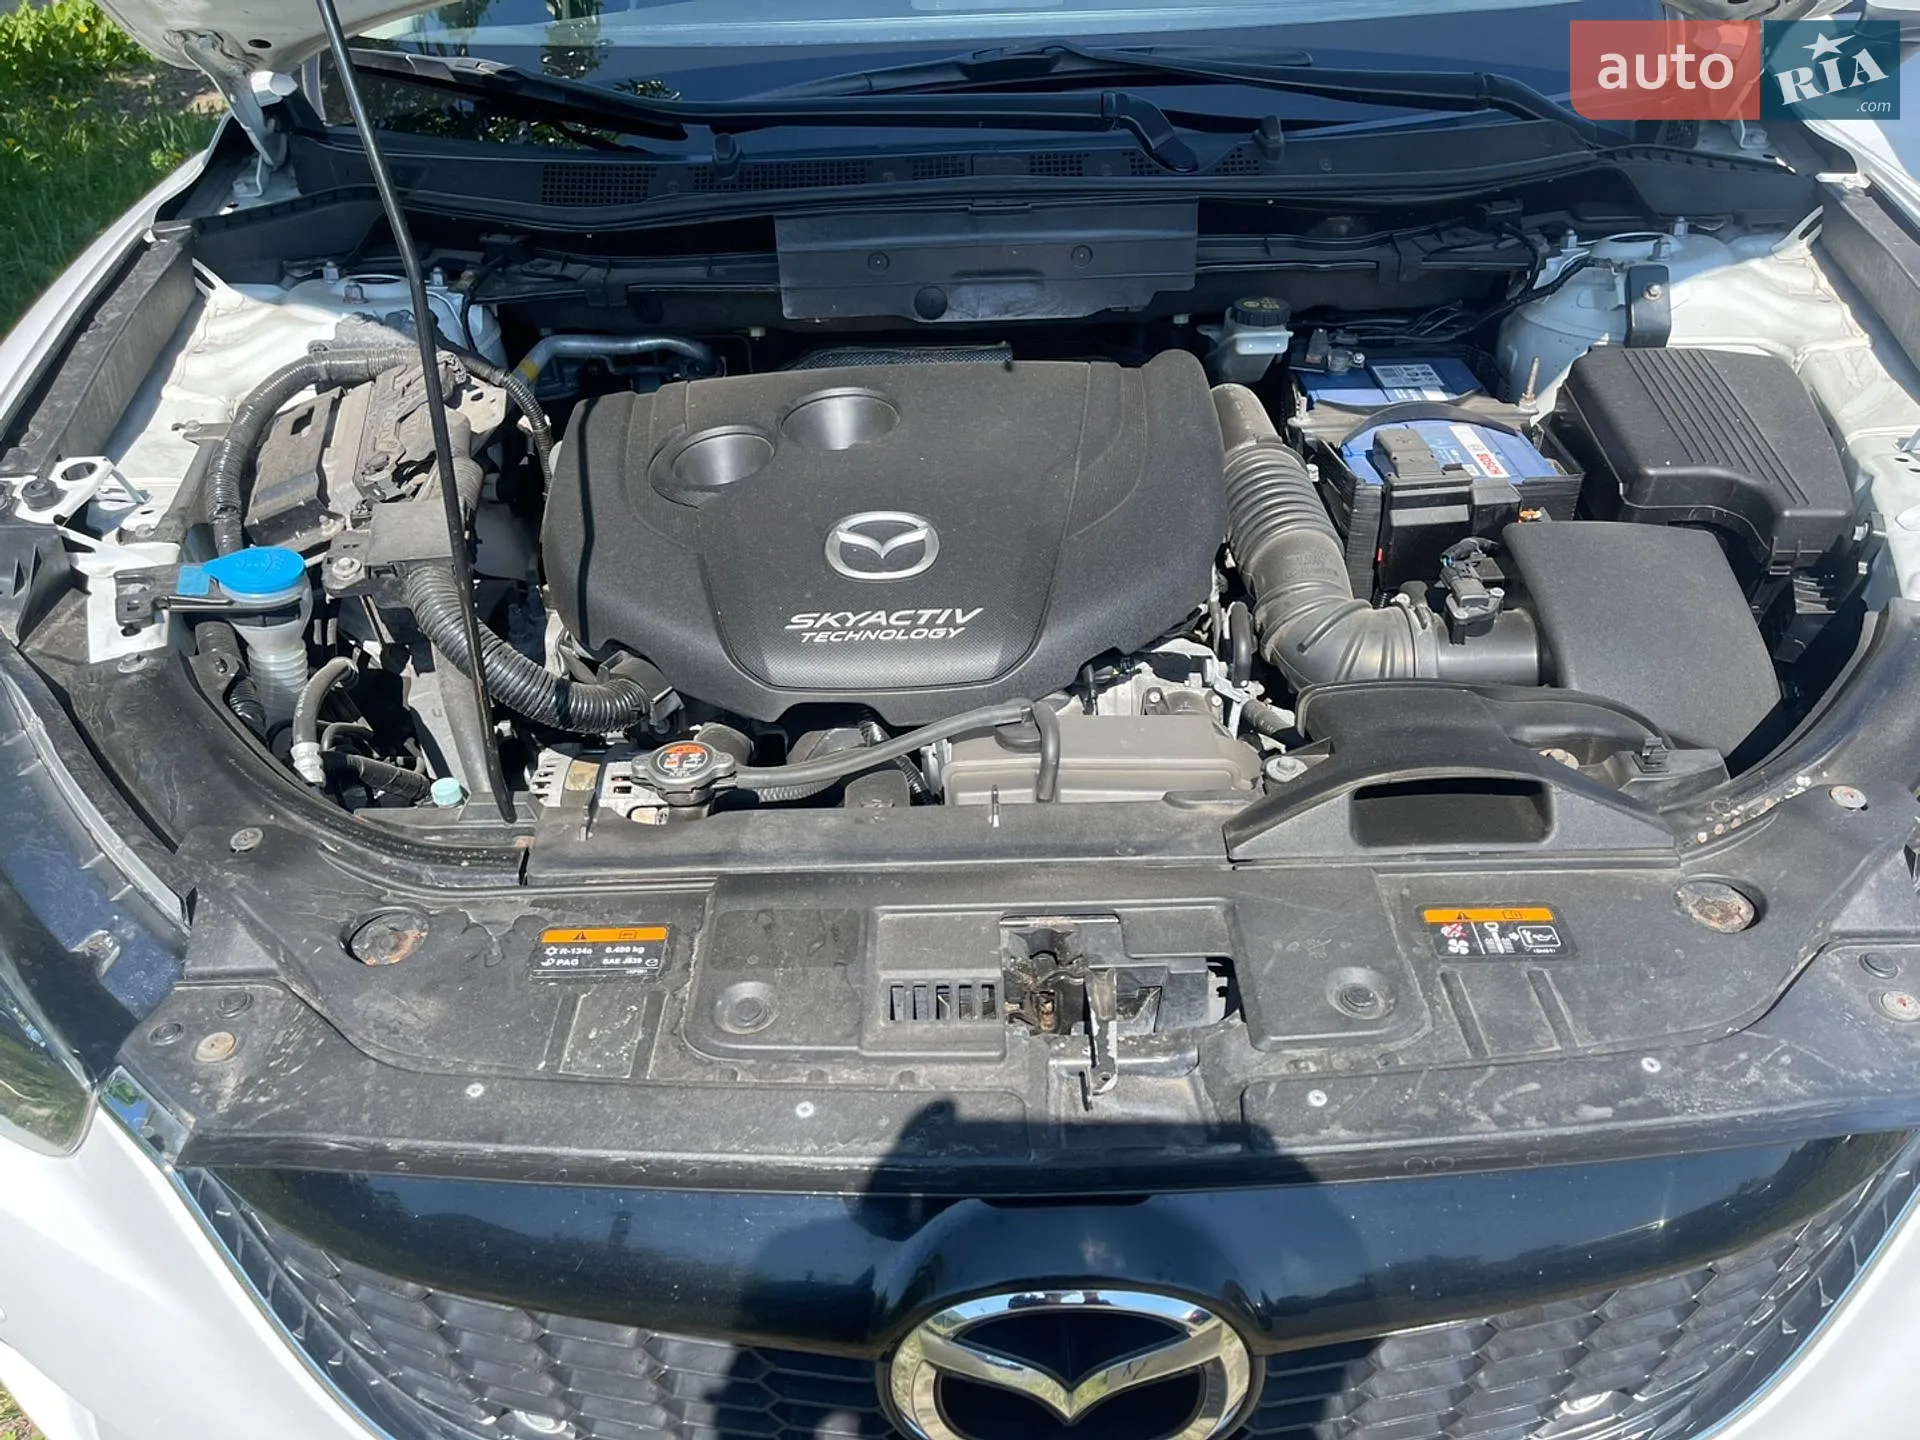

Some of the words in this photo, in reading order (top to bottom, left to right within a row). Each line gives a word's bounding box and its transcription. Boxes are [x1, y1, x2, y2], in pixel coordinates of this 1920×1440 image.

[1476, 452, 1503, 476] BOSCH
[784, 607, 984, 630] SKYACTIV
[800, 627, 966, 644] TECHNOLOGY
